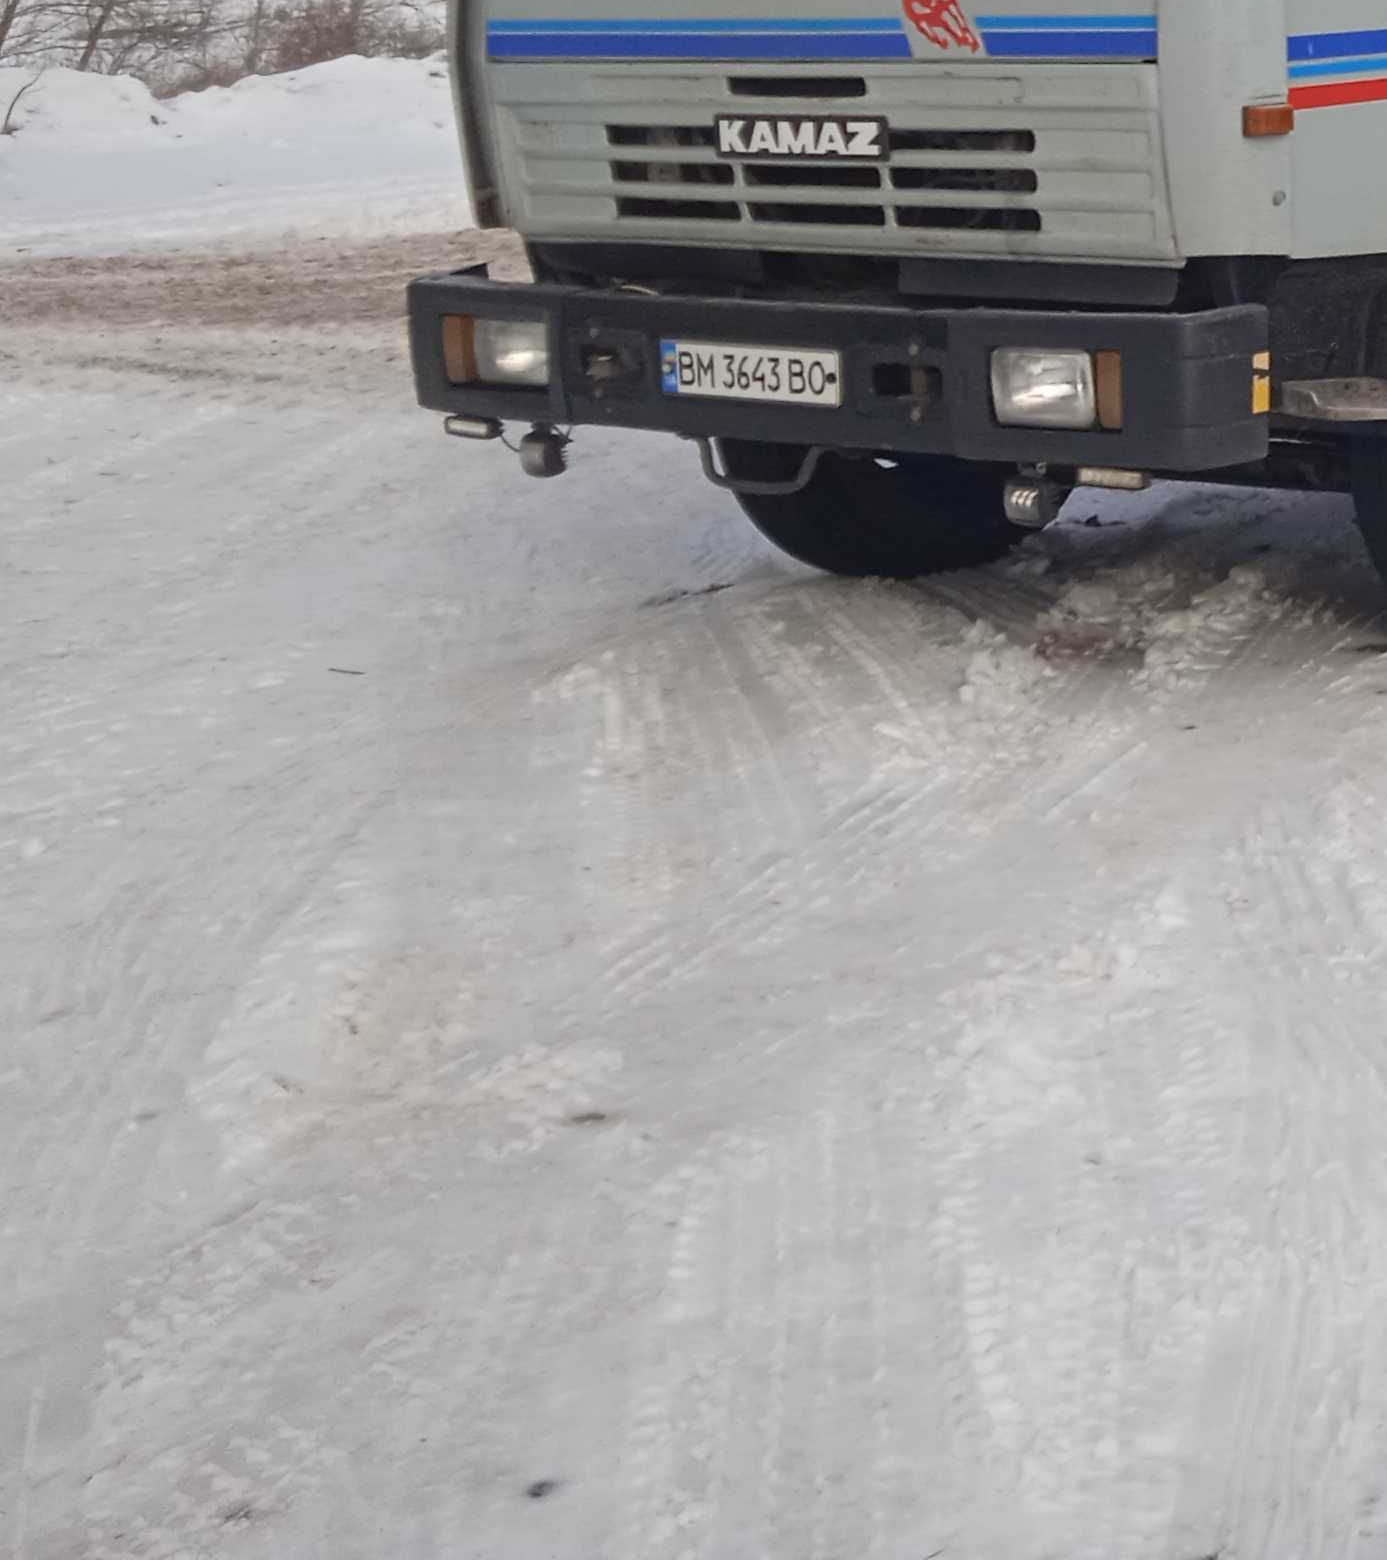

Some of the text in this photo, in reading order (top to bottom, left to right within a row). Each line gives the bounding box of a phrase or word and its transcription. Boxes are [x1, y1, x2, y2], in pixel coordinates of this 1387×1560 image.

[718, 119, 882, 156] KAMAZ
[678, 351, 827, 396] BM 3643 BO
